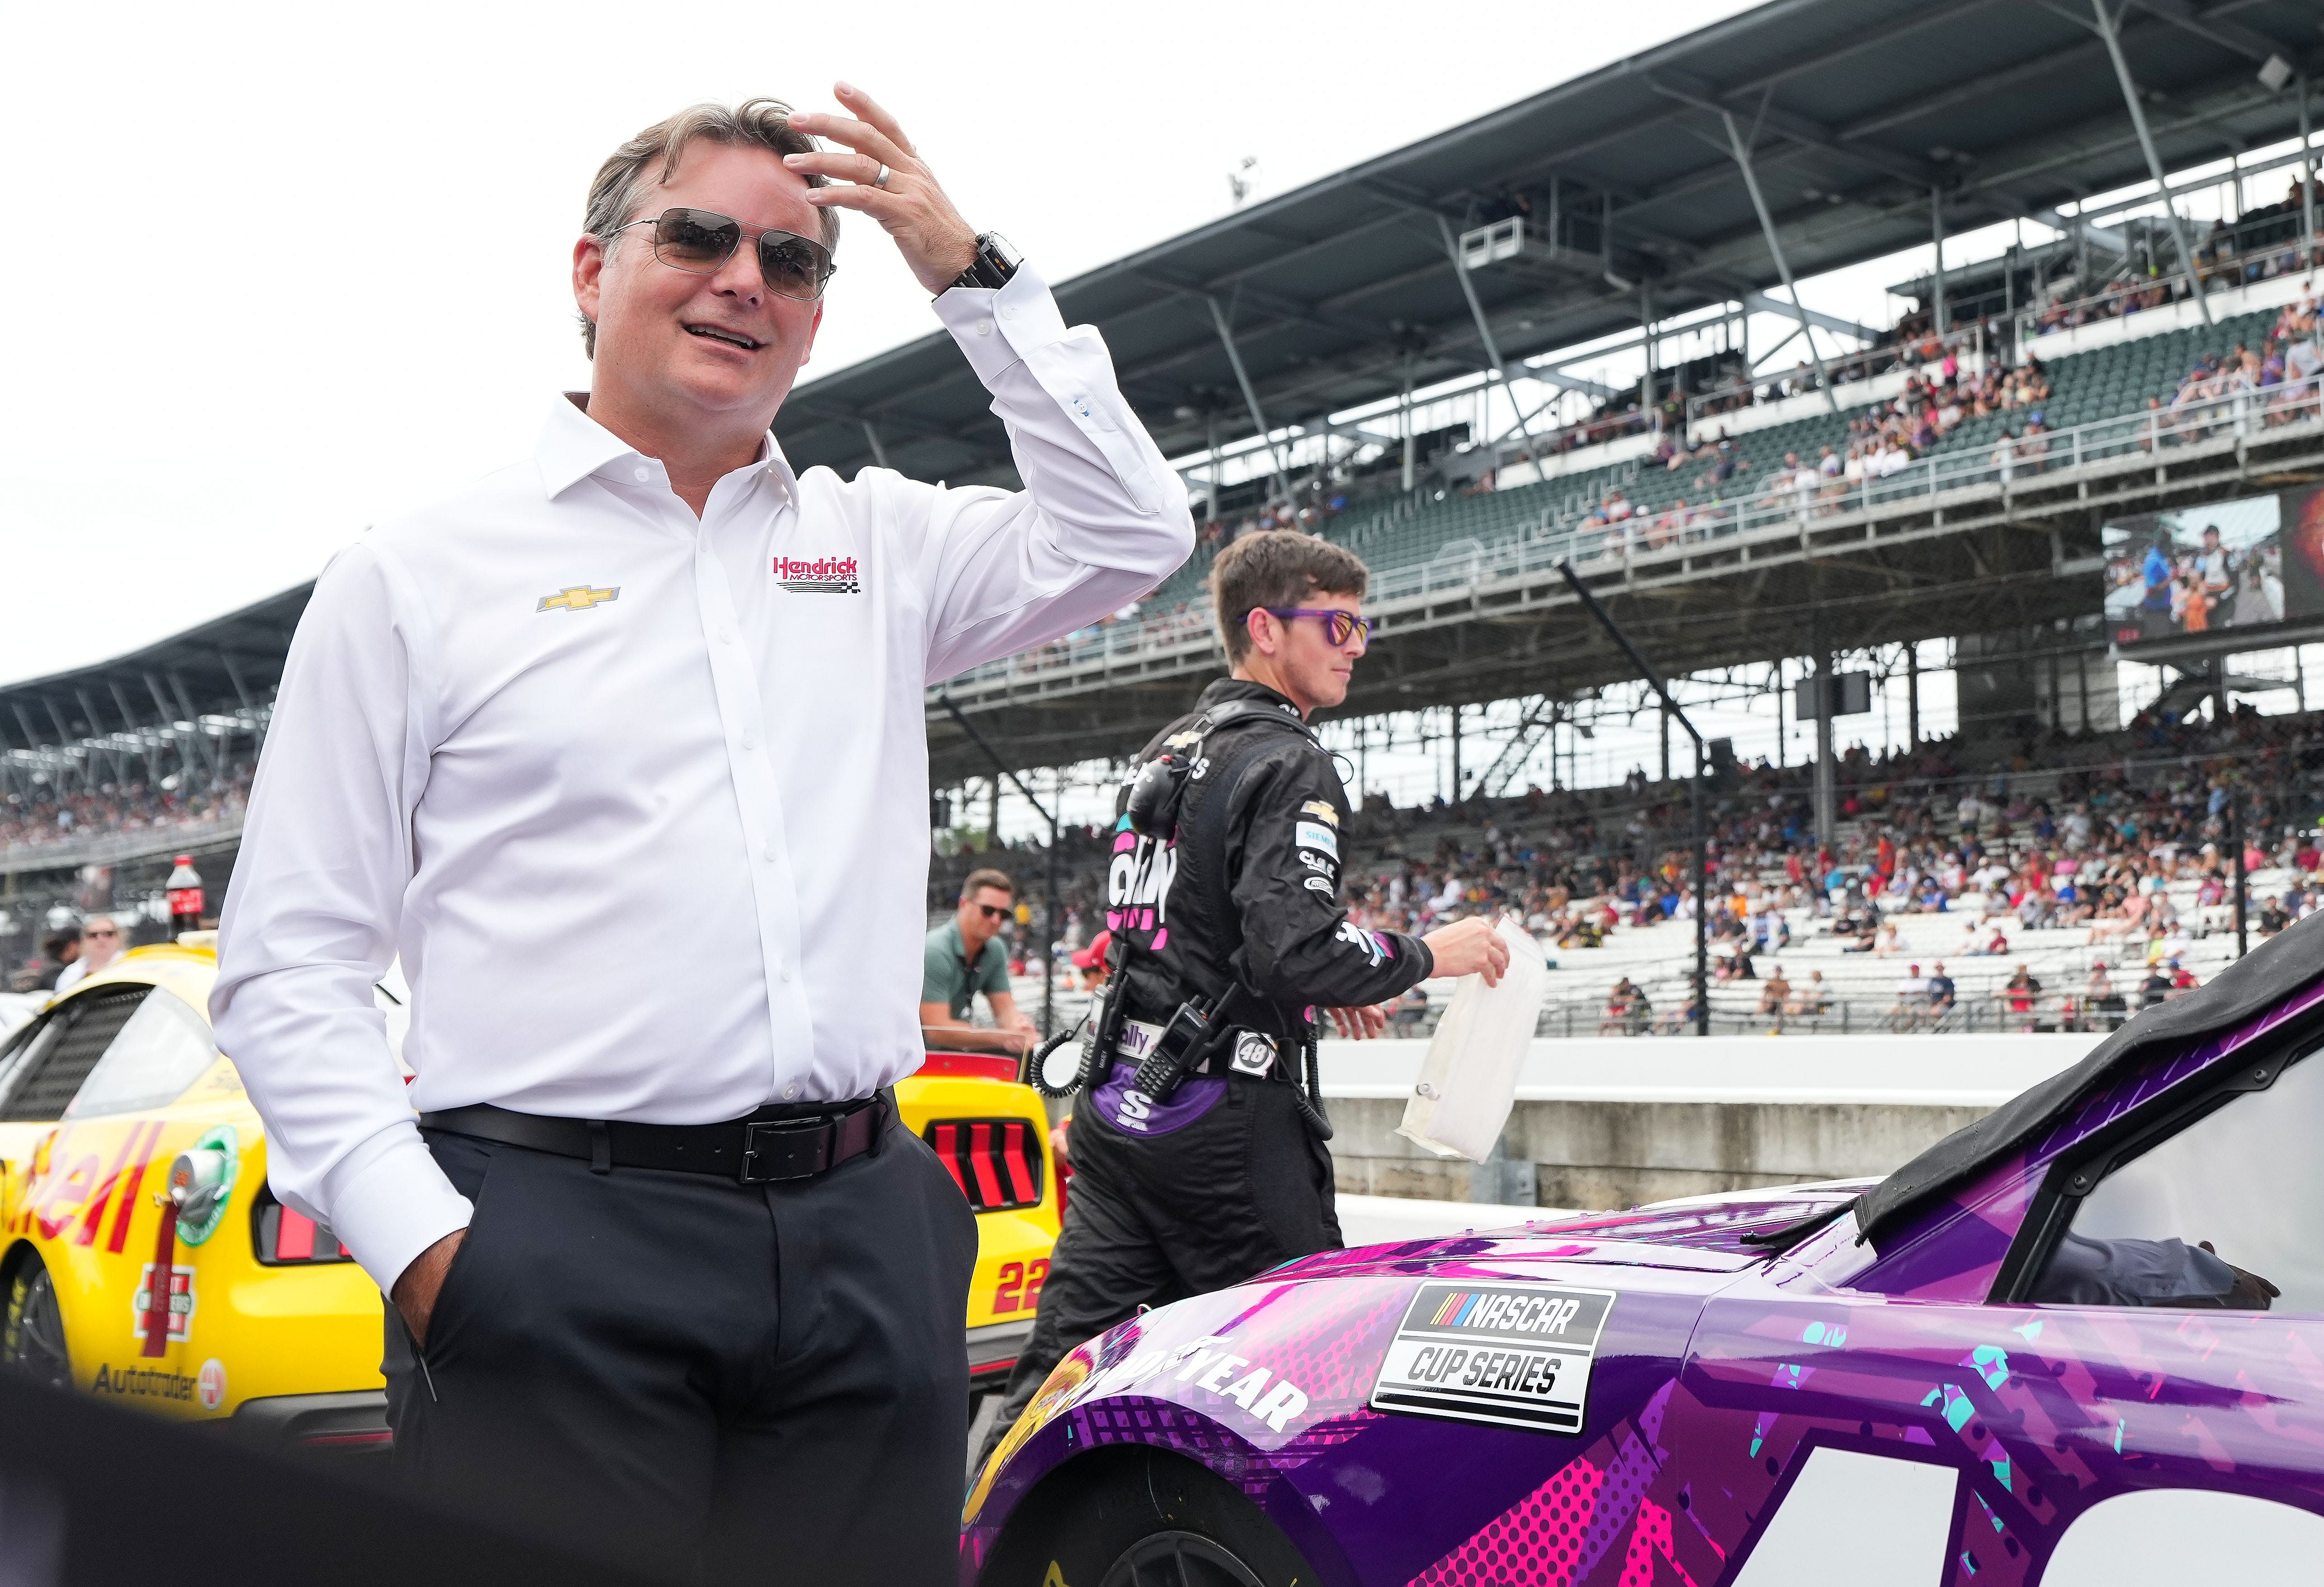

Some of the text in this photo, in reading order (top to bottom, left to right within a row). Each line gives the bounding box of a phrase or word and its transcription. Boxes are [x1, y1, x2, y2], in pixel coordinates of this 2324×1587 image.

[773, 557, 857, 579] Hendrick
[1121, 1025, 1149, 1055] ally
[1239, 1042, 1268, 1063] 48
[1116, 1114, 1149, 1131] SIMPSON
[993, 1258, 1051, 1314] 22
[1462, 1293, 1580, 1335] NASCAR
[1407, 1347, 1562, 1395] CUP SERIES
